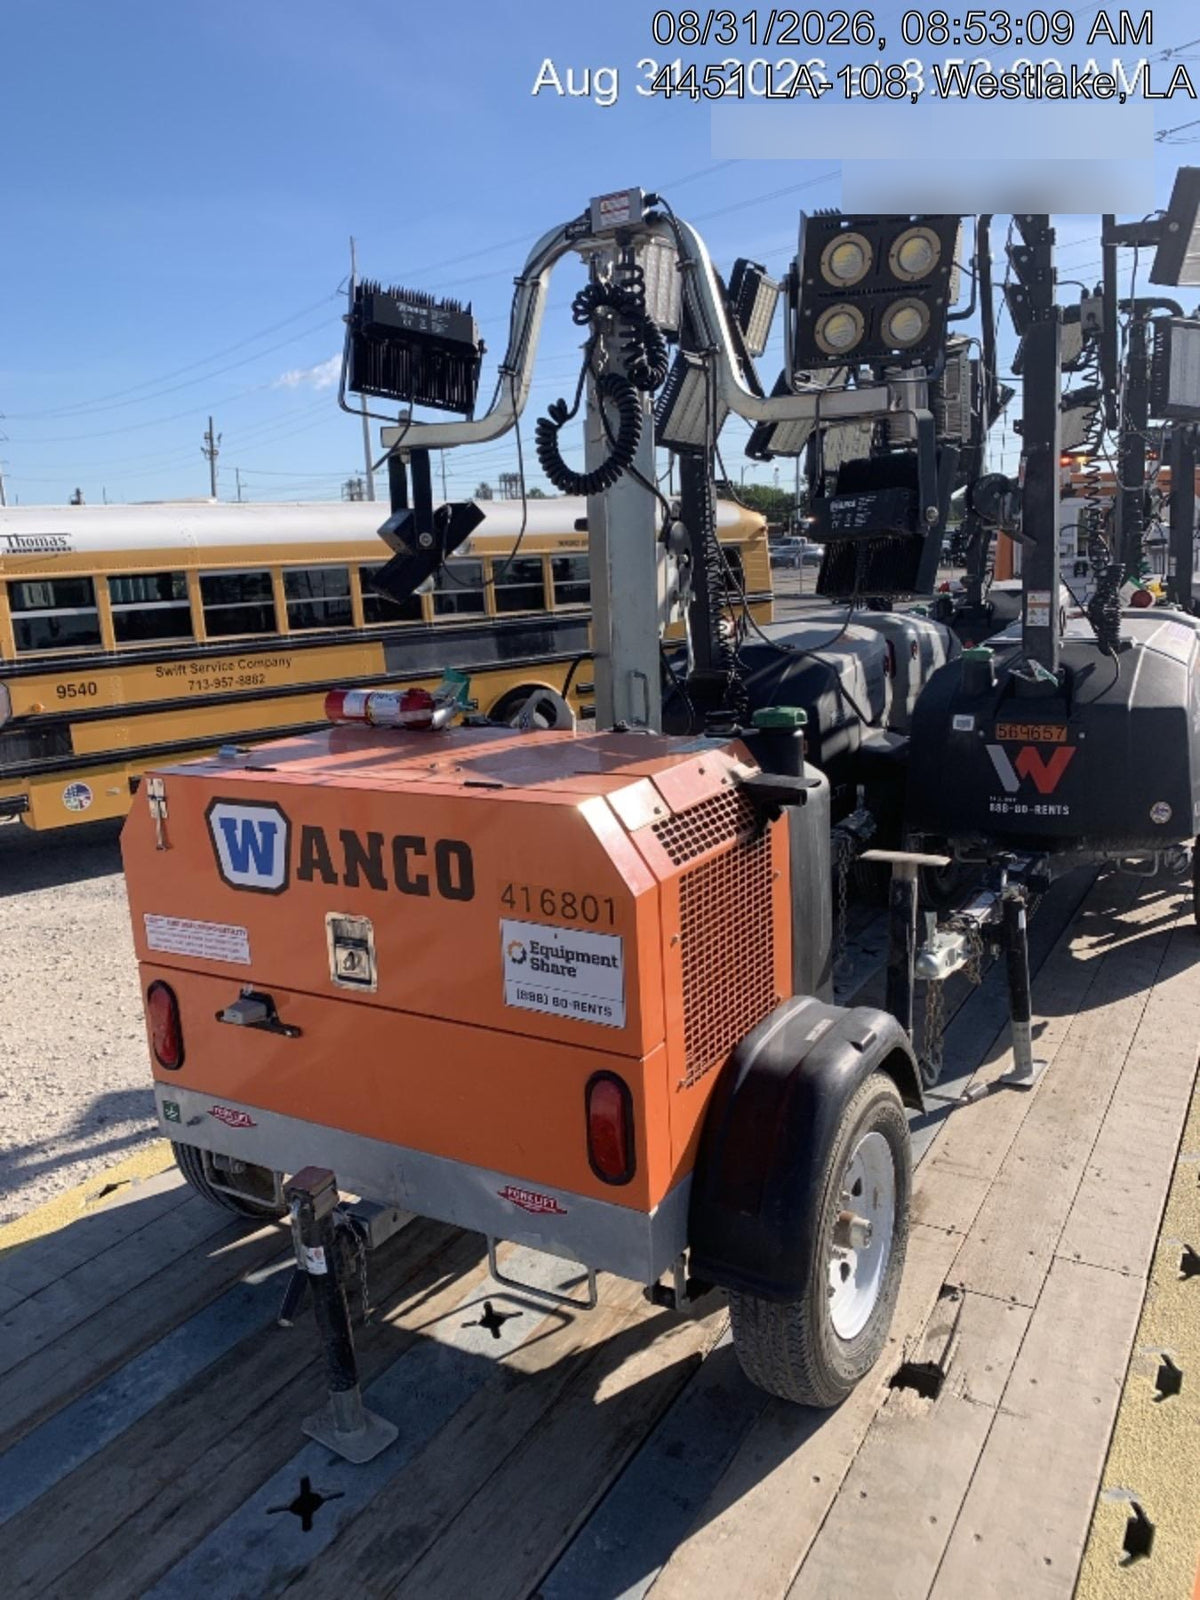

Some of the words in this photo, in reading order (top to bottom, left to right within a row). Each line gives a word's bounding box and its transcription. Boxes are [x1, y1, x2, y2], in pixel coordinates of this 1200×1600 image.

[6, 533, 67, 548] Thomas
[156, 664, 187, 678] Swift
[190, 661, 235, 675] Service
[238, 657, 292, 670] Company
[56, 681, 97, 699] 9540
[218, 817, 475, 902] WANCO
[501, 883, 616, 926] 416801
[530, 940, 619, 969] Equipment
[530, 957, 577, 978] Share
